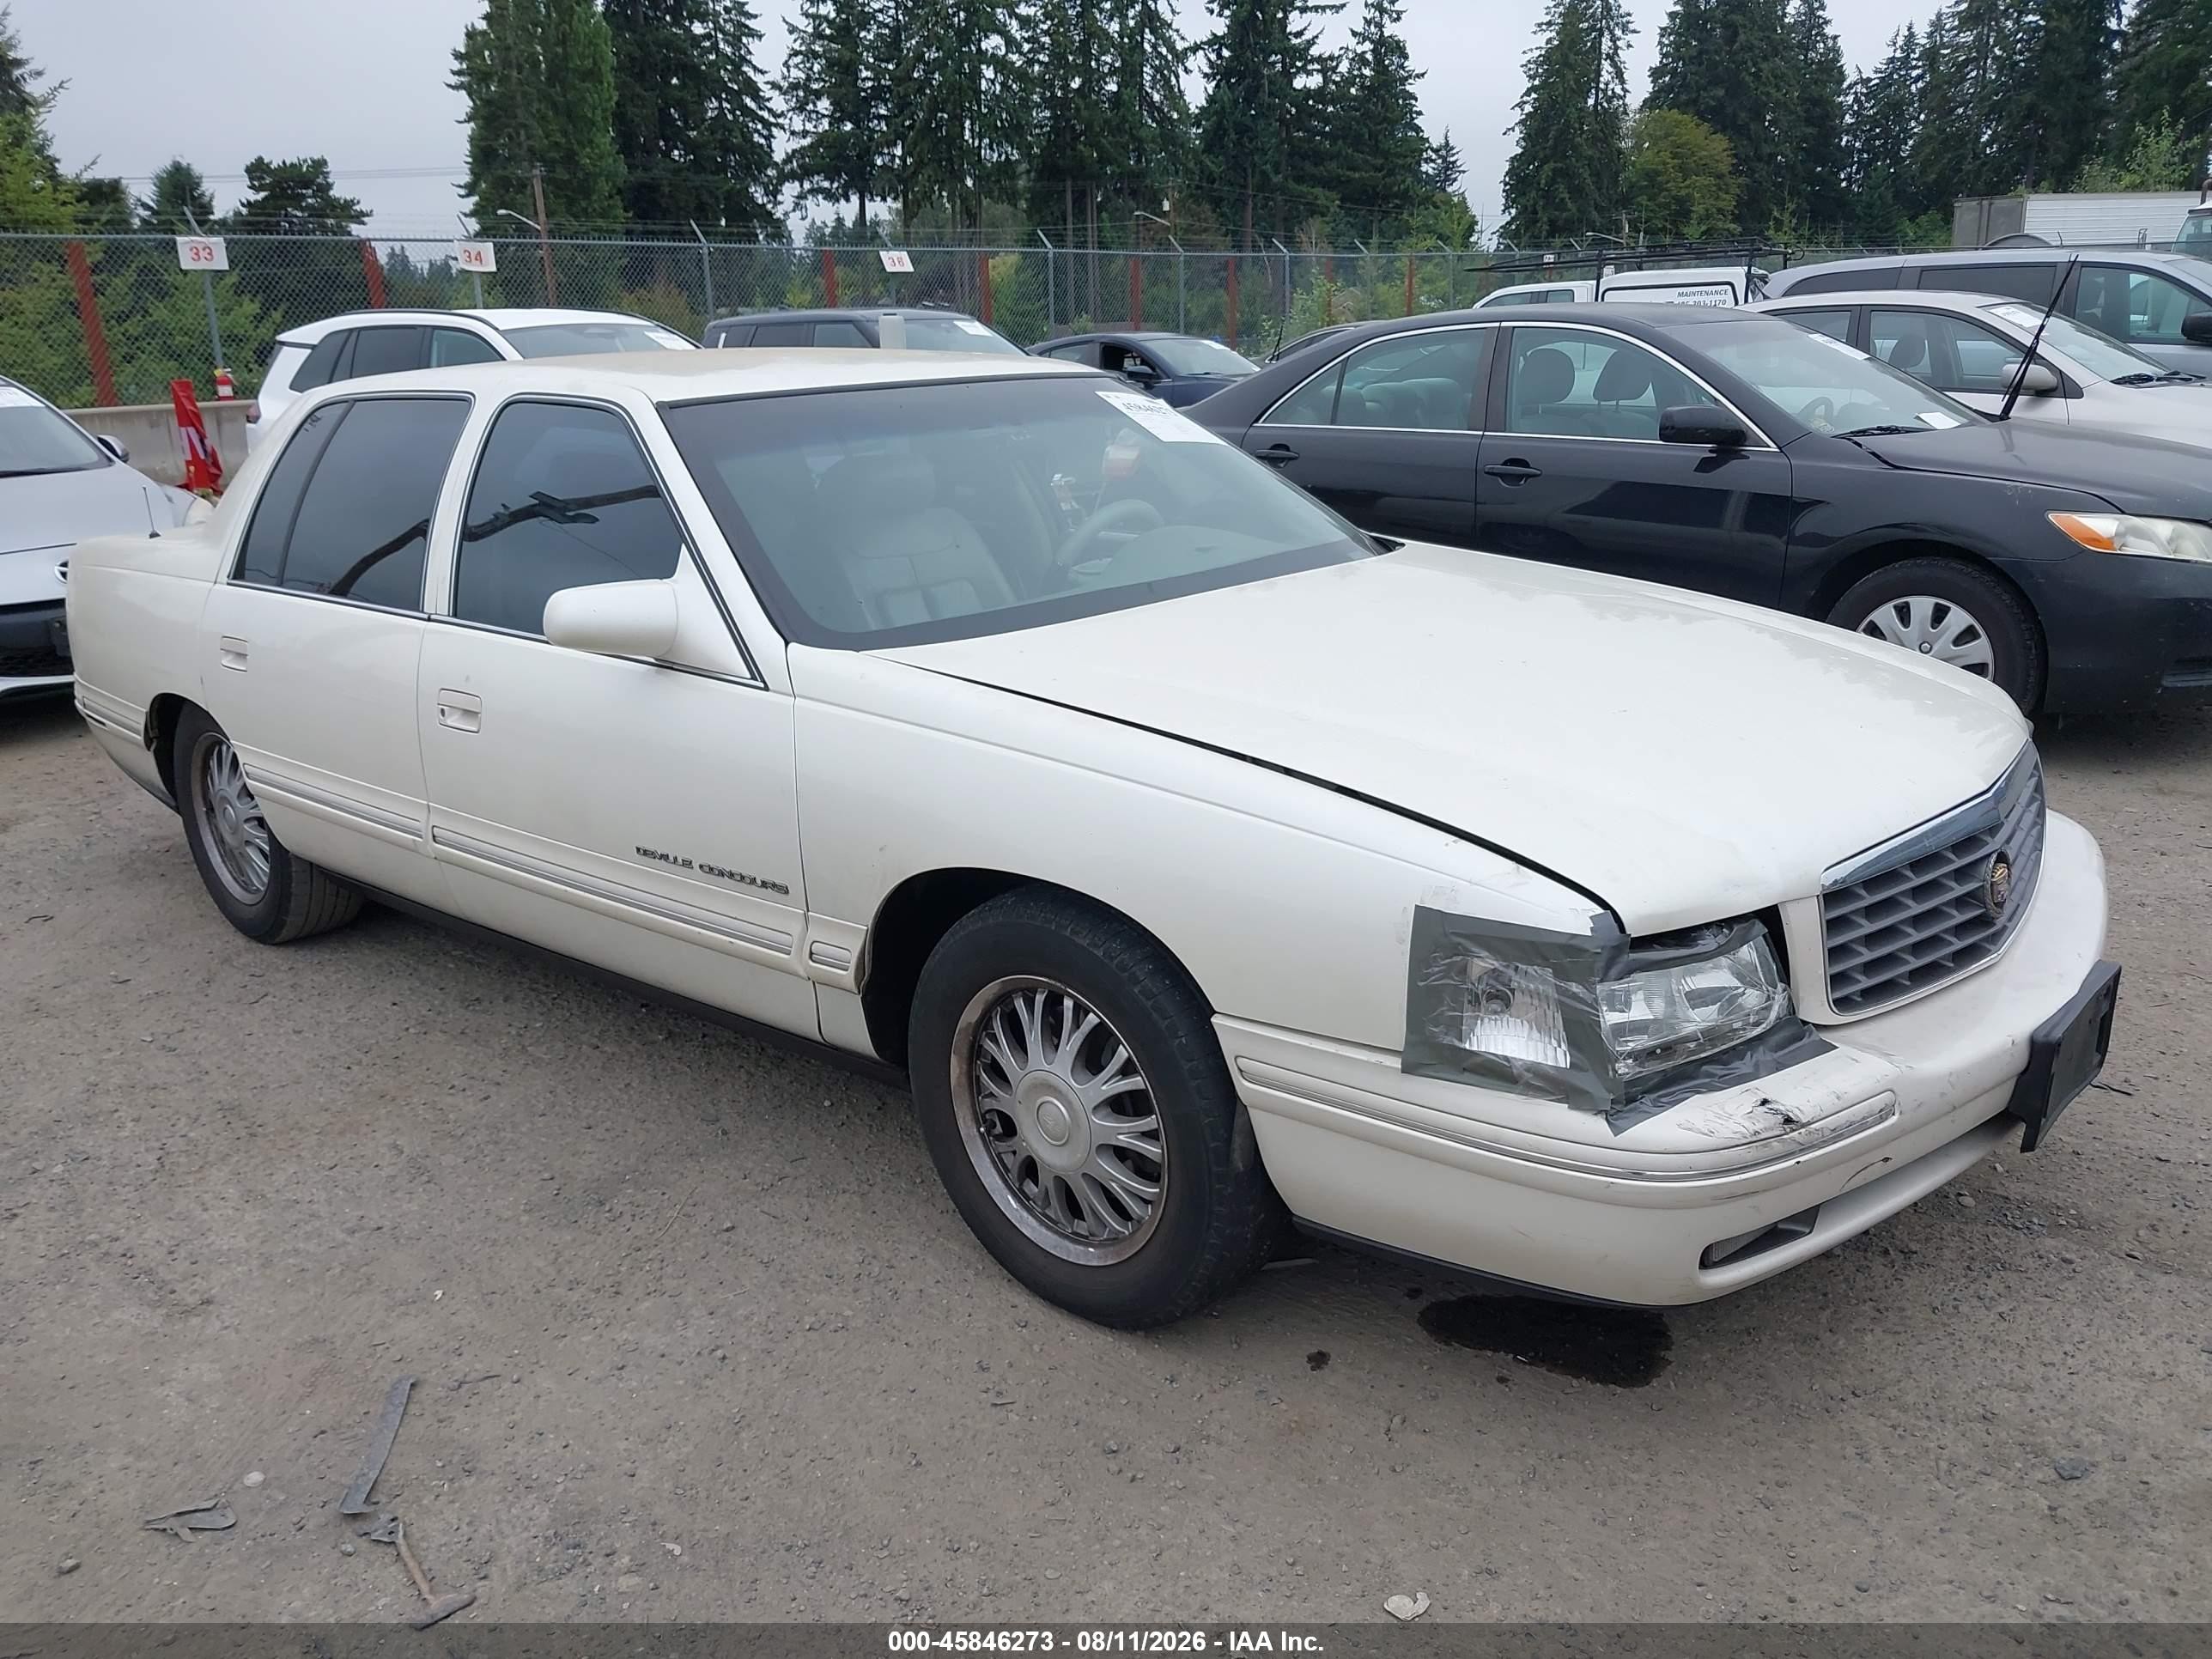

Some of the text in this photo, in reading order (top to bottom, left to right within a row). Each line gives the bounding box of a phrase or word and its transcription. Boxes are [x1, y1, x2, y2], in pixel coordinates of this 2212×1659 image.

[189, 246, 214, 262] 33
[463, 249, 483, 265] 34
[1677, 289, 1729, 298] MAINTENANCE
[635, 846, 790, 894] DEVILLE CONCOURS
